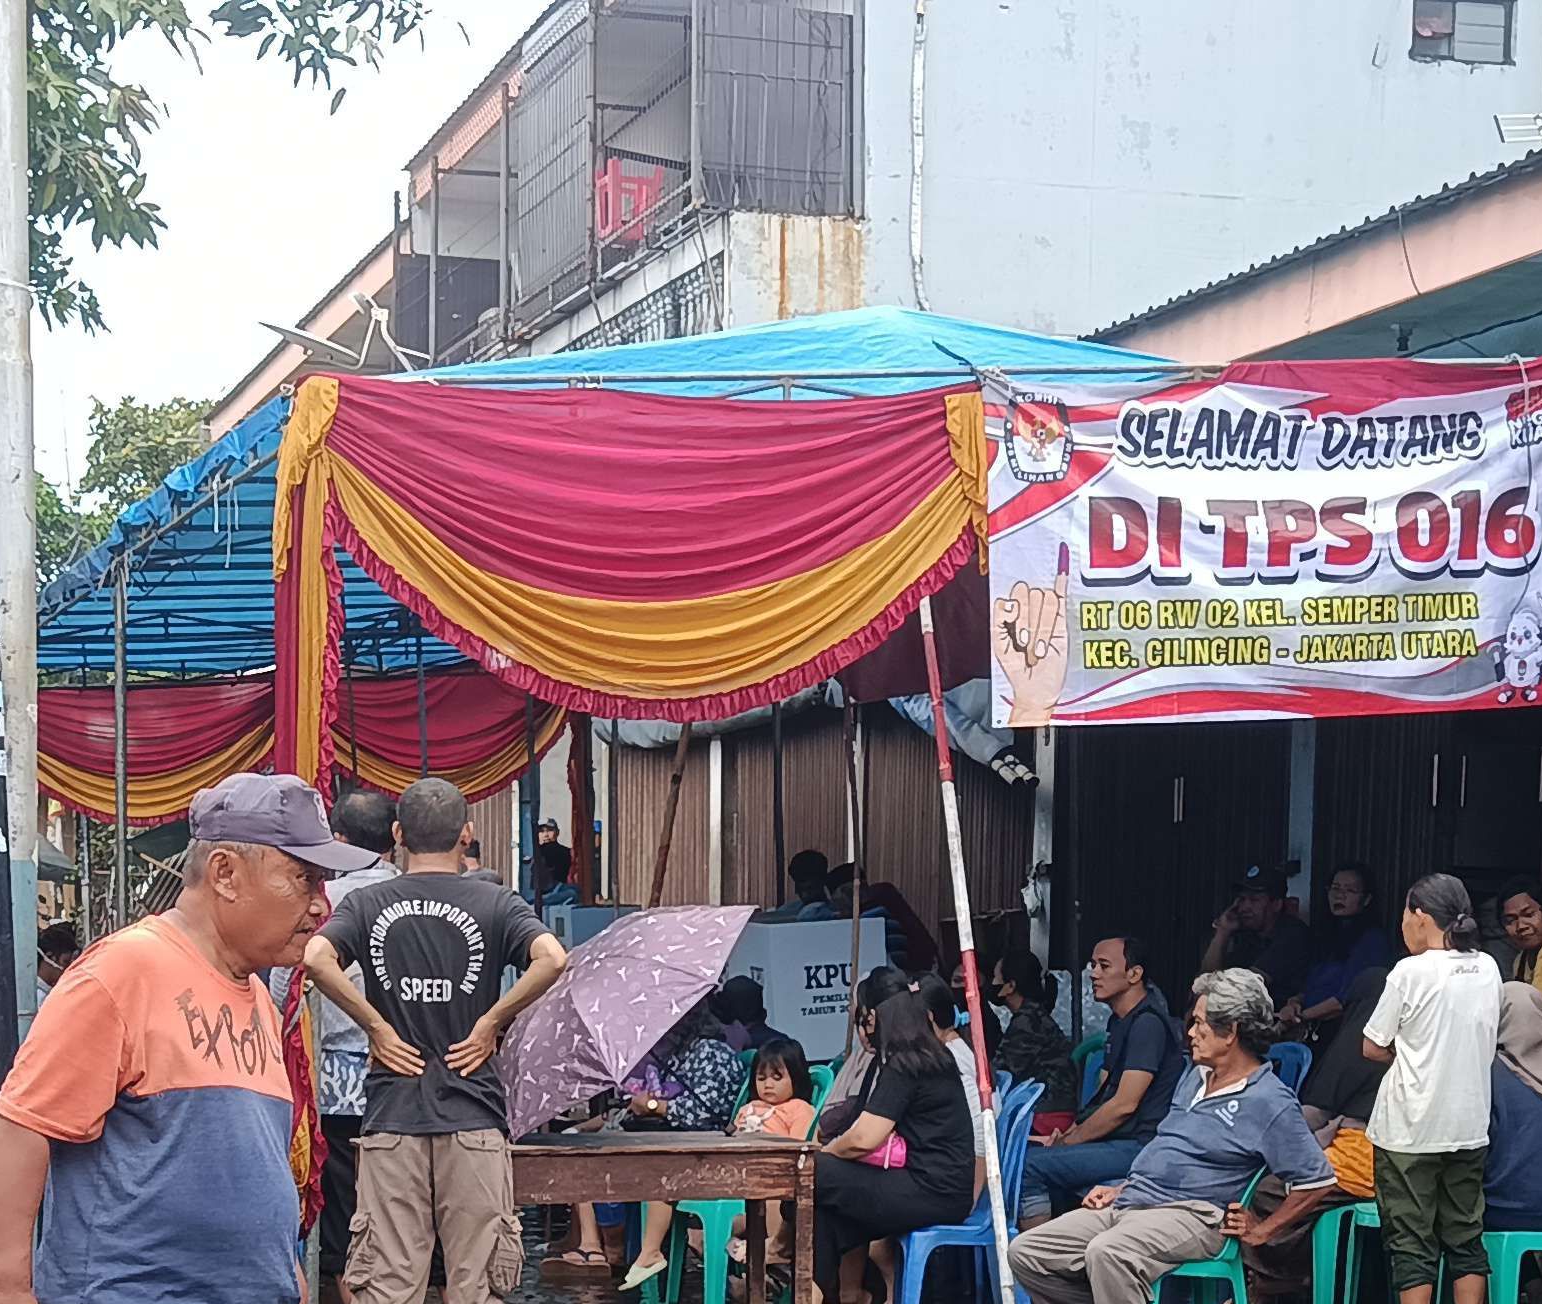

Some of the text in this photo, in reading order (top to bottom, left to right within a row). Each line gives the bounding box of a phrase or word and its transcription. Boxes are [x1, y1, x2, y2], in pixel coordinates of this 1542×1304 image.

[1116, 407, 1484, 460] SELAMAT DATANG
[1088, 486, 1537, 569] DI TPS 016
[1081, 592, 1479, 630] RT 06 RW 02 KEL. SEMPER TIMUR
[1083, 639, 1139, 669] KEC.
[1145, 636, 1270, 666] CILINCING
[1294, 632, 1395, 664] JAKARTA
[1401, 629, 1479, 659] UTARA
[370, 899, 485, 995] DIRECTION MORE IMPORTANT THAN
[400, 976, 453, 1003] SPEED
[804, 963, 852, 989] KPU
